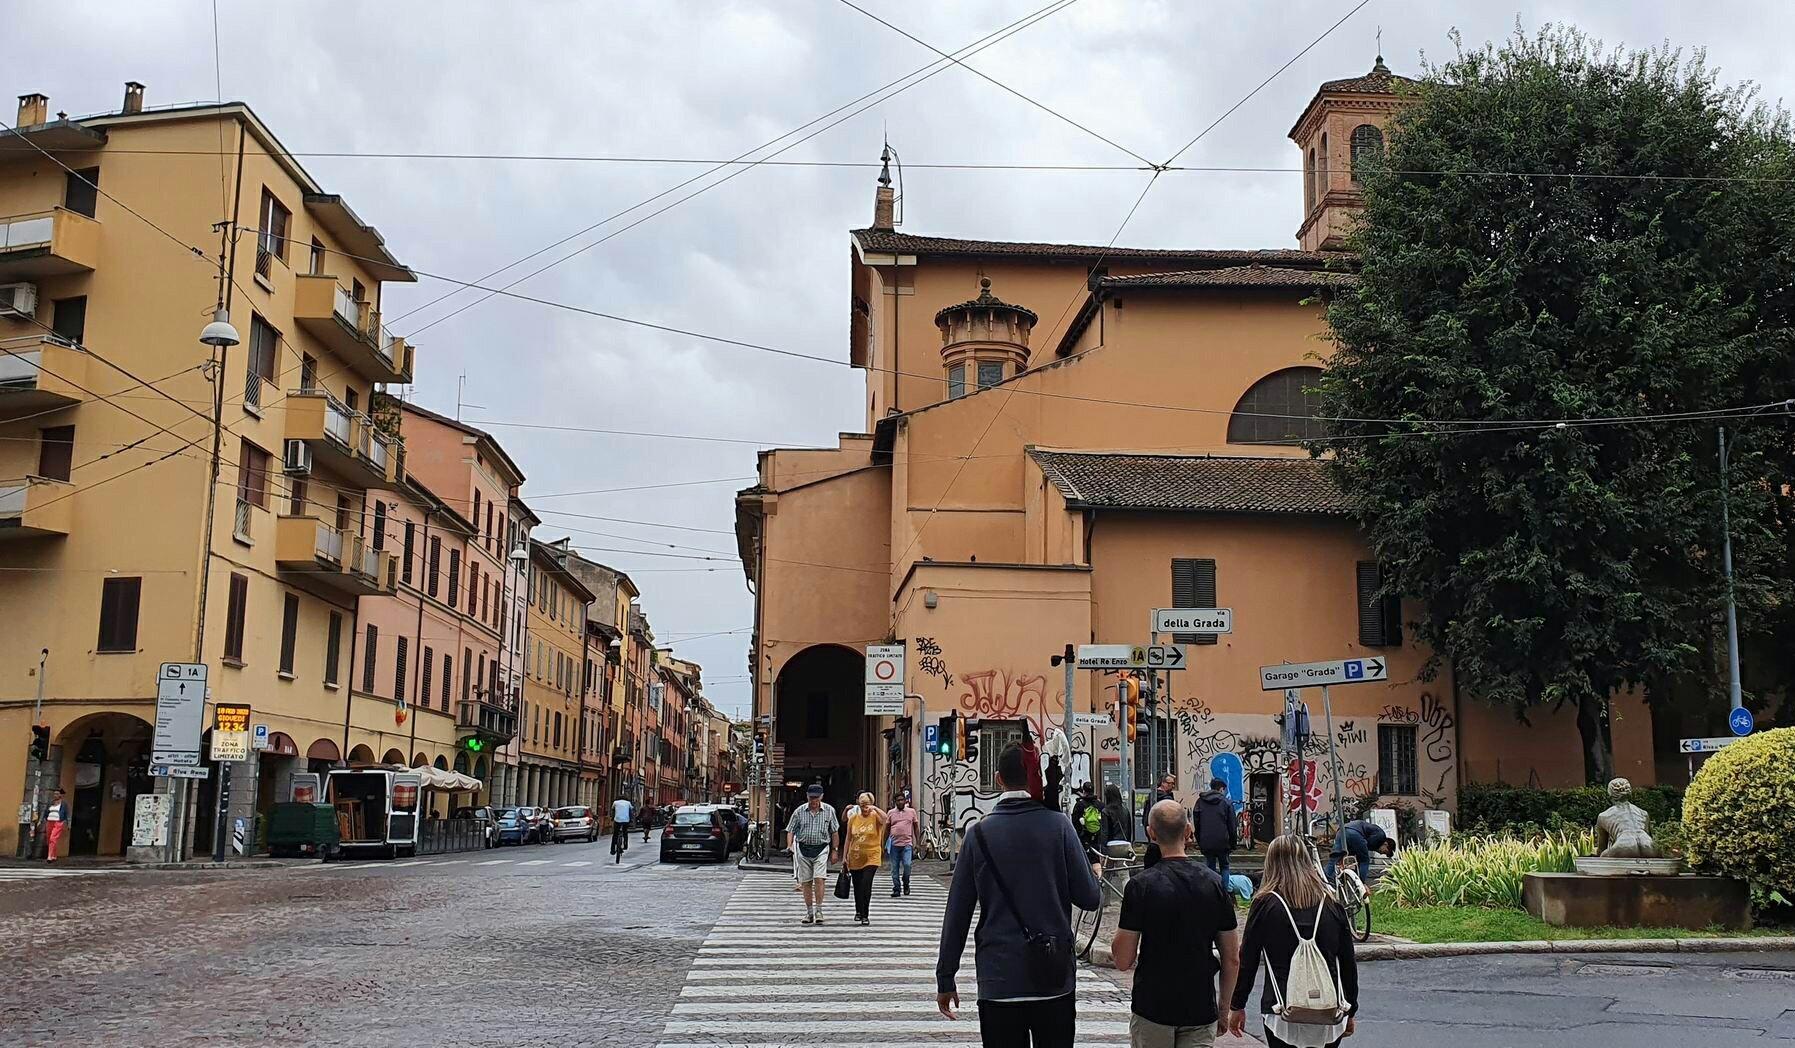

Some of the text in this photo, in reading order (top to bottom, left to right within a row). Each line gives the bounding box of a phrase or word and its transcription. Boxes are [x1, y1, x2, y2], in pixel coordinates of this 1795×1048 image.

[1163, 618, 1225, 628] della Grada
[1132, 650, 1145, 662] 1A
[1080, 658, 1099, 666] Hotel
[188, 668, 199, 677] 1A
[1264, 672, 1299, 681] Garage
[1301, 666, 1340, 677] "Grada"
